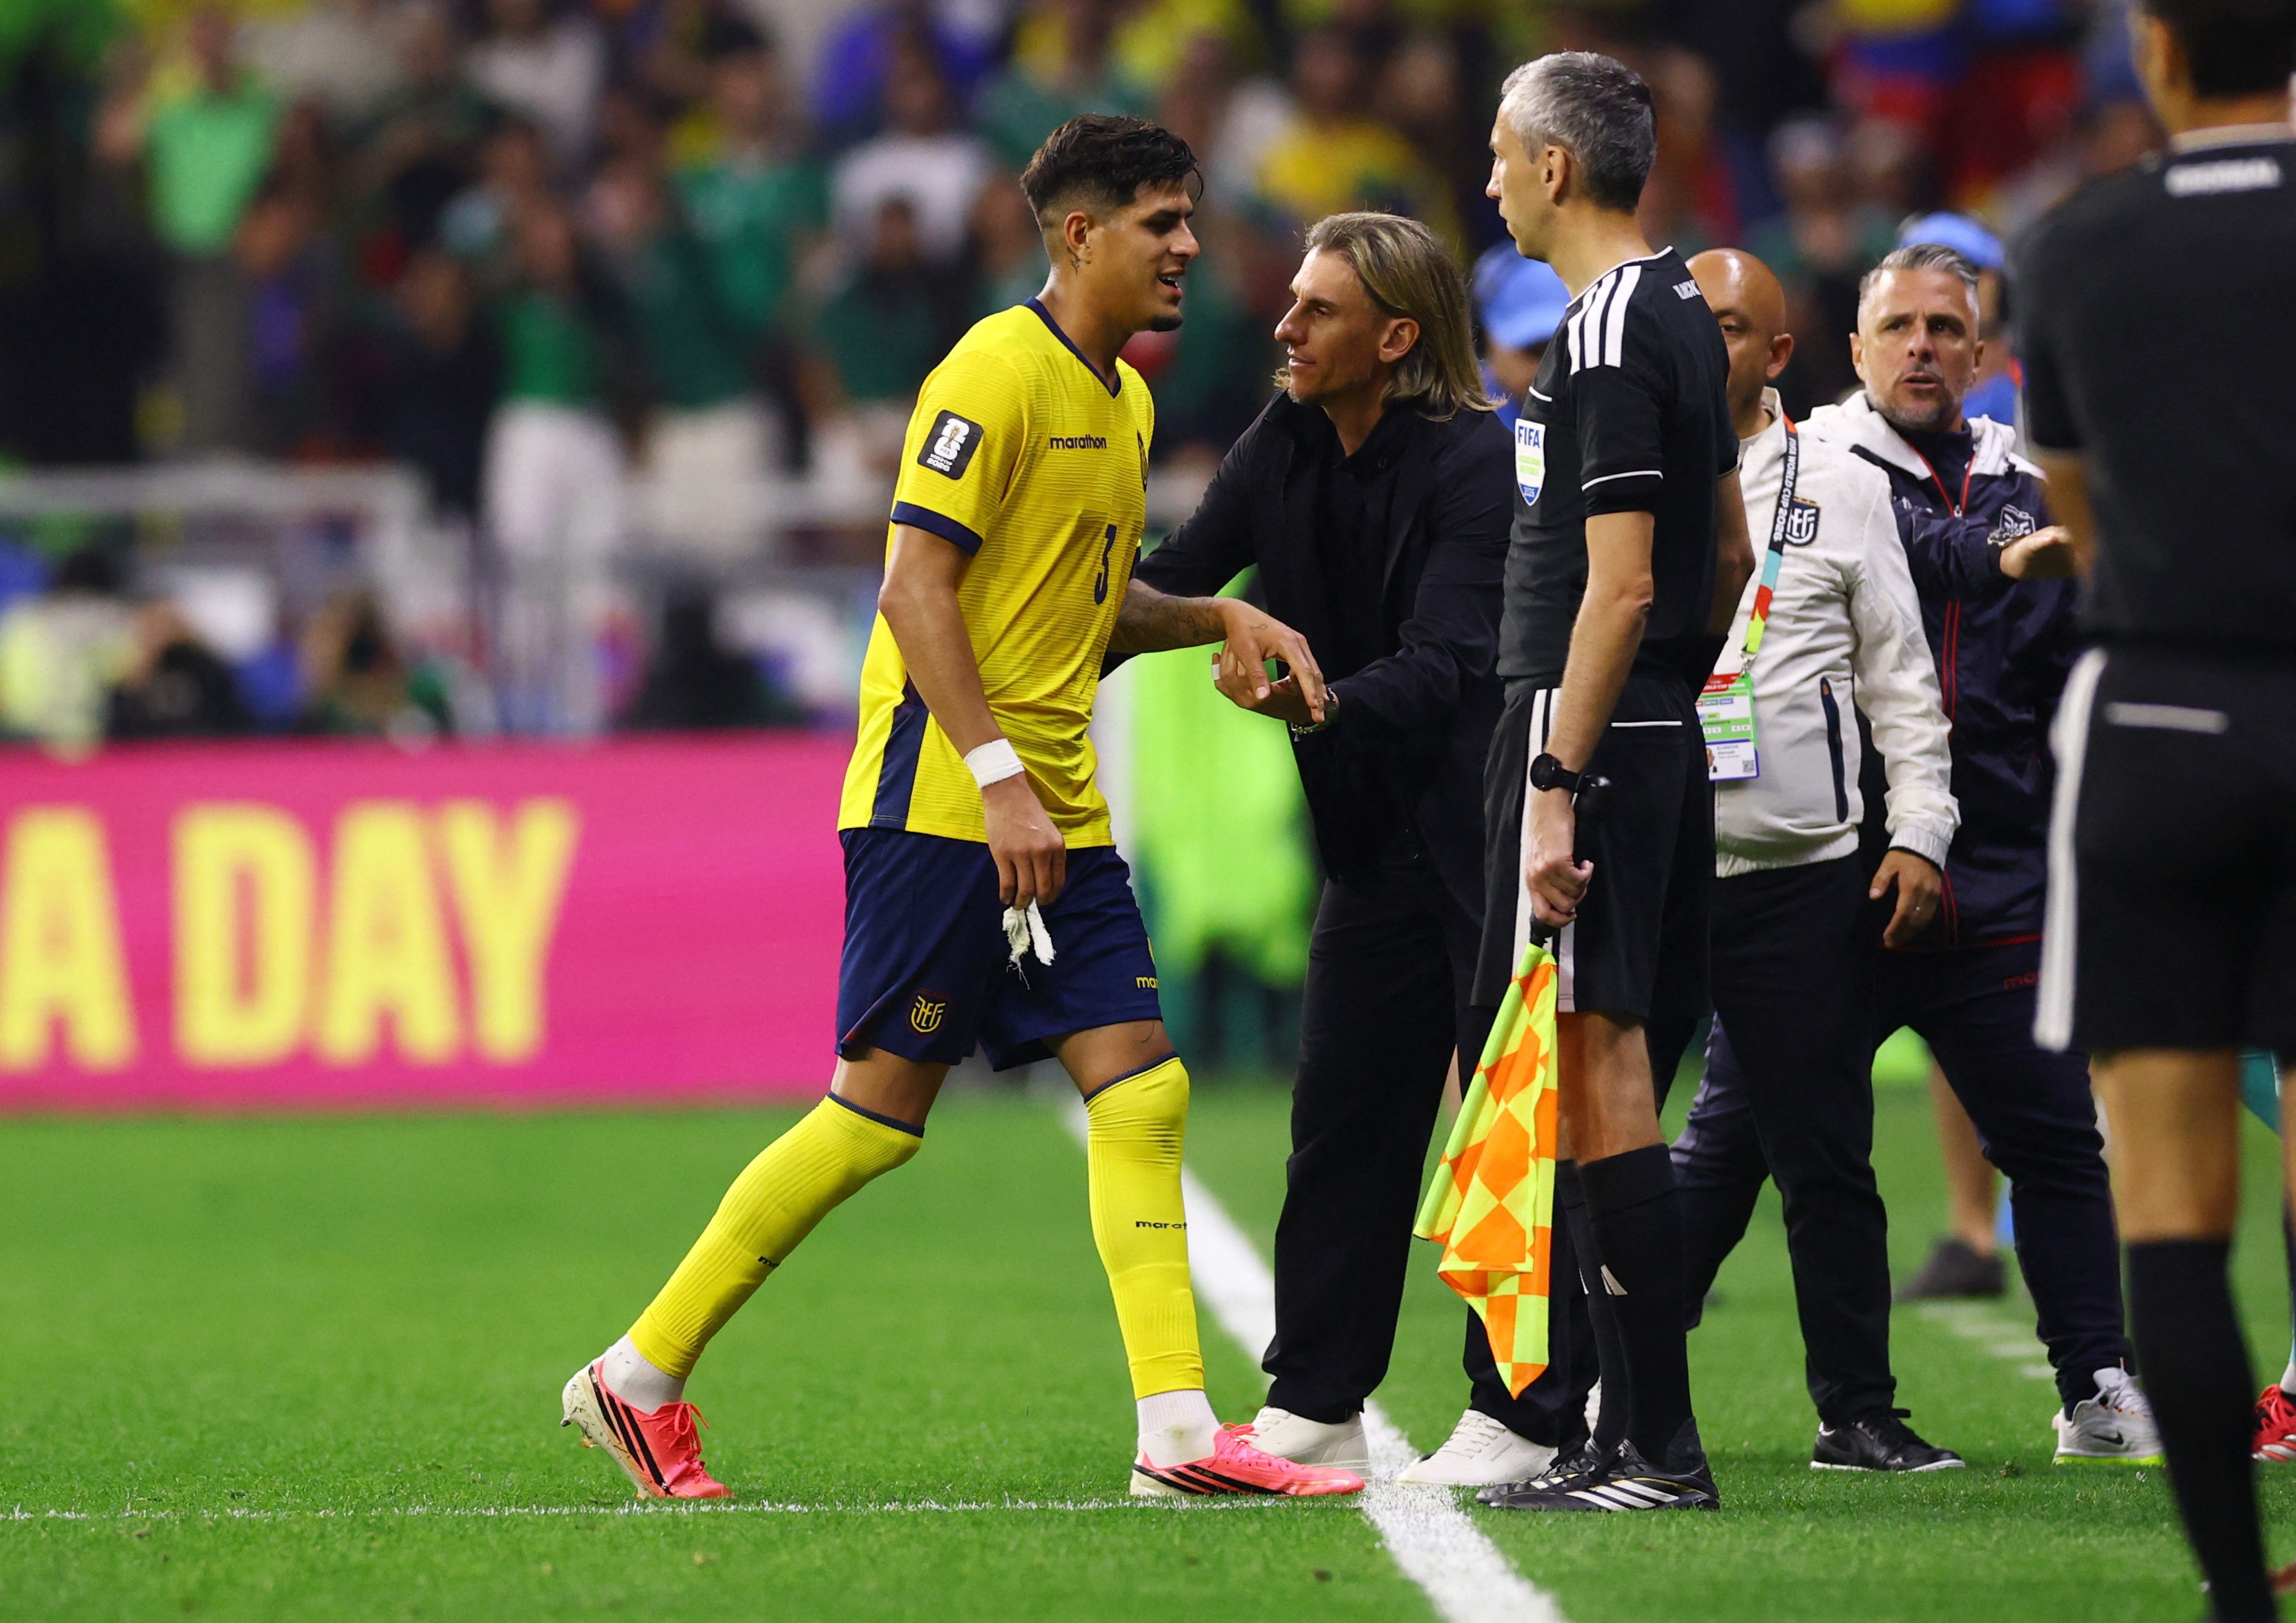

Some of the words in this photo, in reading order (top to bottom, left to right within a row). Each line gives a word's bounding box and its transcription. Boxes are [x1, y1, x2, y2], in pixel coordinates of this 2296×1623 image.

[1050, 434, 1107, 449] marathon
[1518, 425, 1541, 449] FIFA
[1788, 436, 1797, 455] FIFA
[926, 458, 951, 472] 2026
[1784, 455, 1796, 488] WORLD
[1781, 487, 1792, 508] CUP
[1773, 507, 1787, 542] 2026
[1094, 524, 1117, 605] 3
[0, 804, 134, 1072] A
[173, 795, 579, 1067] DAY
